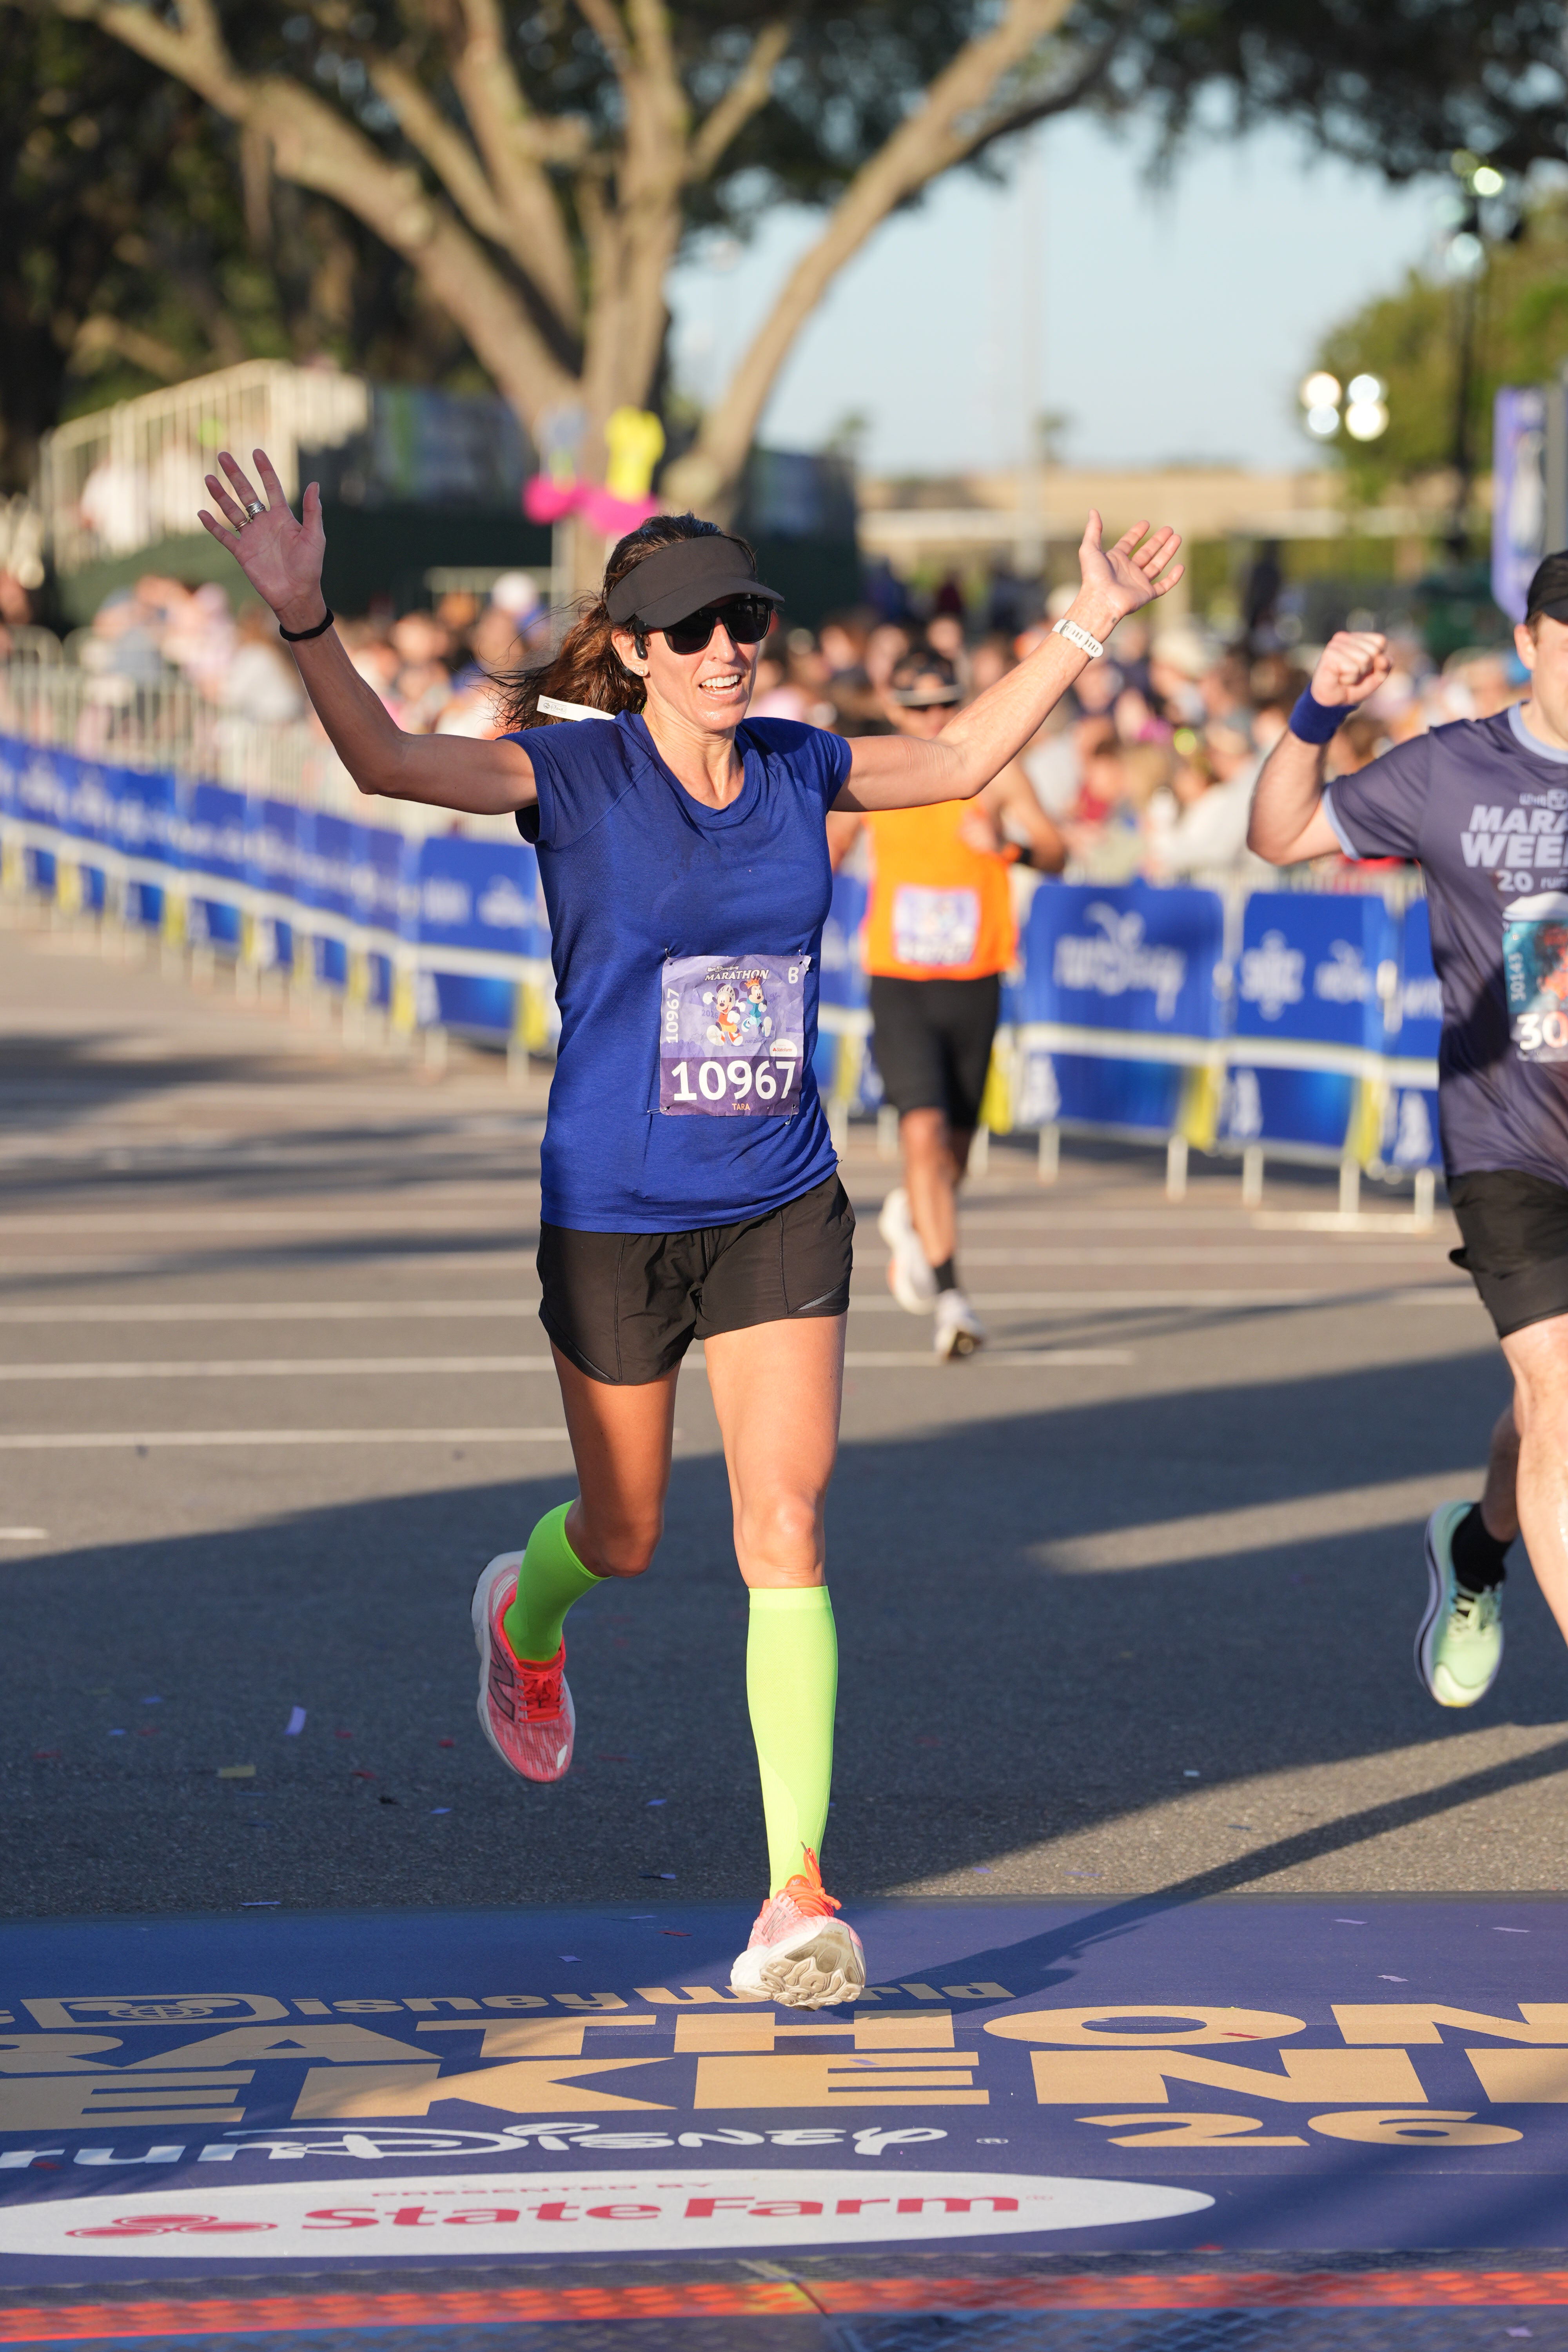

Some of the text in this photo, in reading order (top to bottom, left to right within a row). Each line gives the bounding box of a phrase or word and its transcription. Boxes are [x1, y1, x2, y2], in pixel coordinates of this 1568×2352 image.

[1460, 832, 1568, 867] WEE
[1495, 868, 1534, 893] 20
[704, 969, 769, 981] MARATHON
[788, 967, 799, 984] B
[666, 988, 679, 1044] 10967
[702, 1009, 719, 1019] 2026
[1516, 1011, 1568, 1050] 30
[671, 1060, 796, 1101] 10967
[633, 1982, 1016, 2004] Wrld
